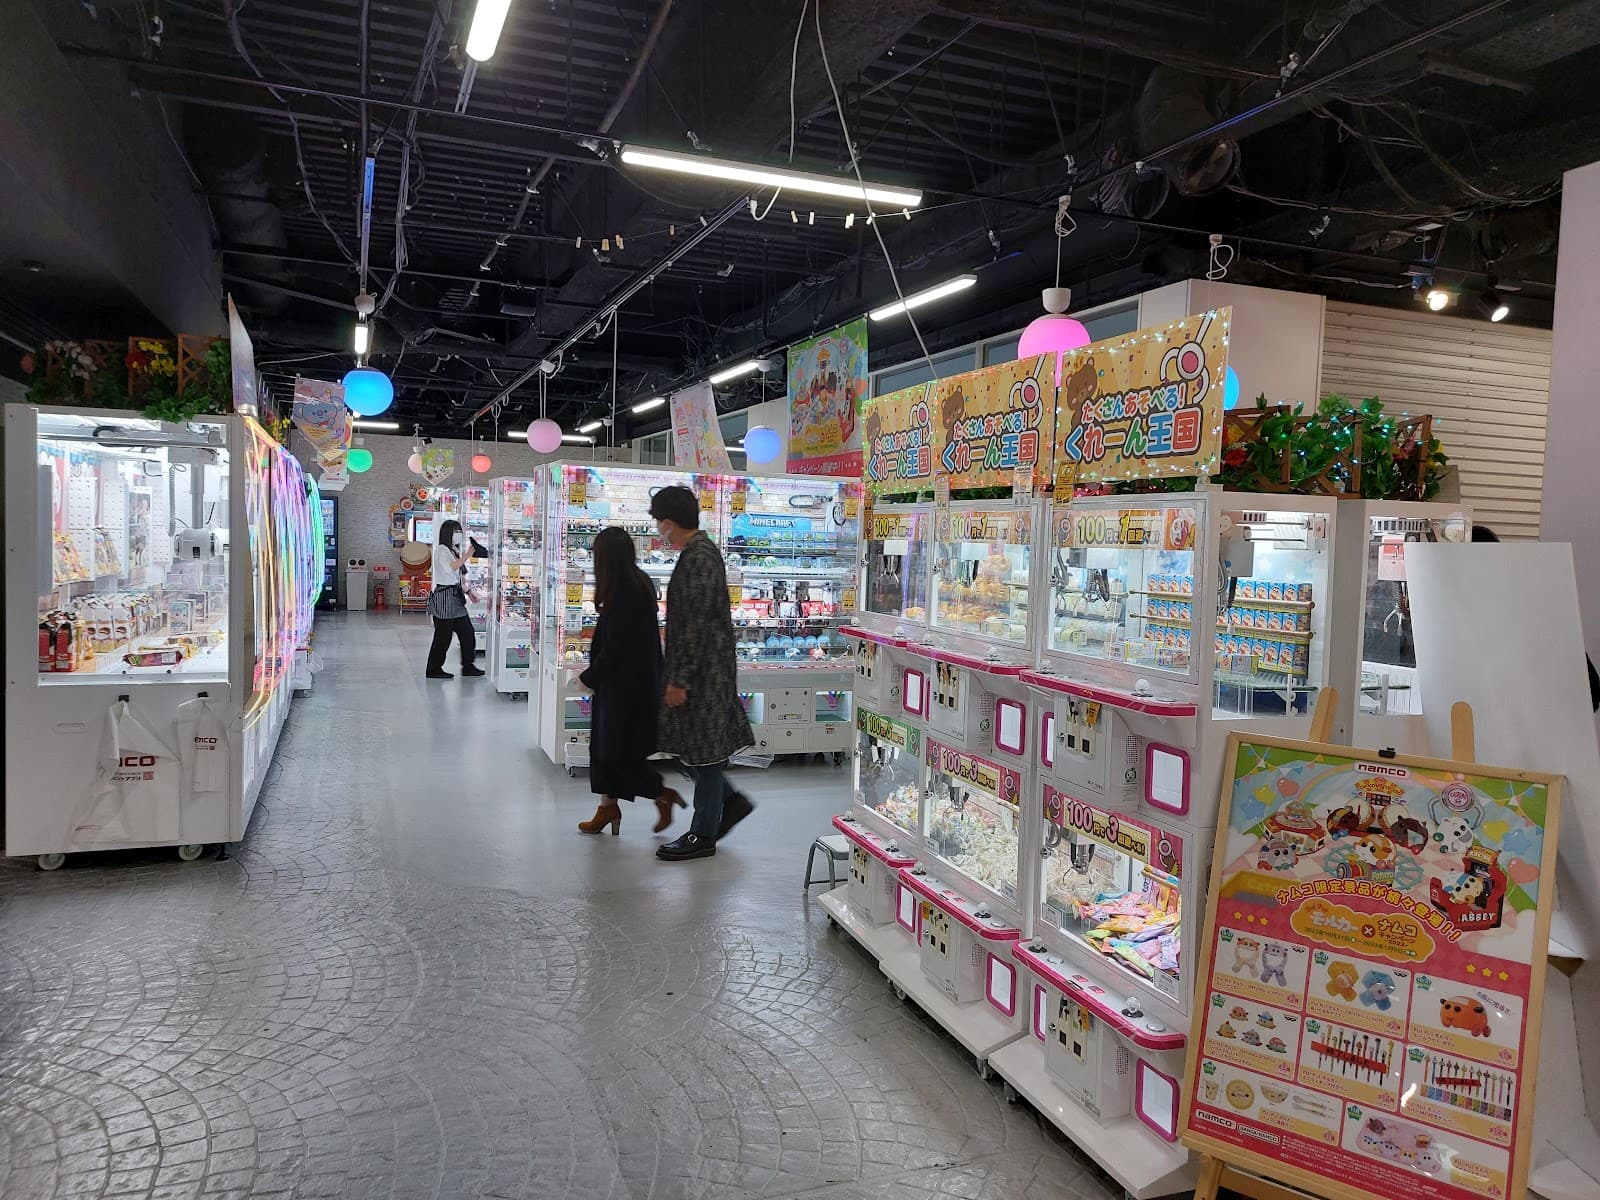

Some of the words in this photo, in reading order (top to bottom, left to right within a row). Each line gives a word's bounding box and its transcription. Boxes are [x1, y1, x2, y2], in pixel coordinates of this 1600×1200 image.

[1082, 383, 1187, 424] たくさんあそべる!
[1065, 407, 1202, 461] くれーん王国
[868, 445, 930, 481] くれーん王国
[942, 430, 1039, 472] くれーん王国
[749, 518, 796, 528] MINECRAFT
[1358, 763, 1406, 777] namco
[1378, 918, 1417, 937] ナムコ
[1198, 1111, 1232, 1127] namco
